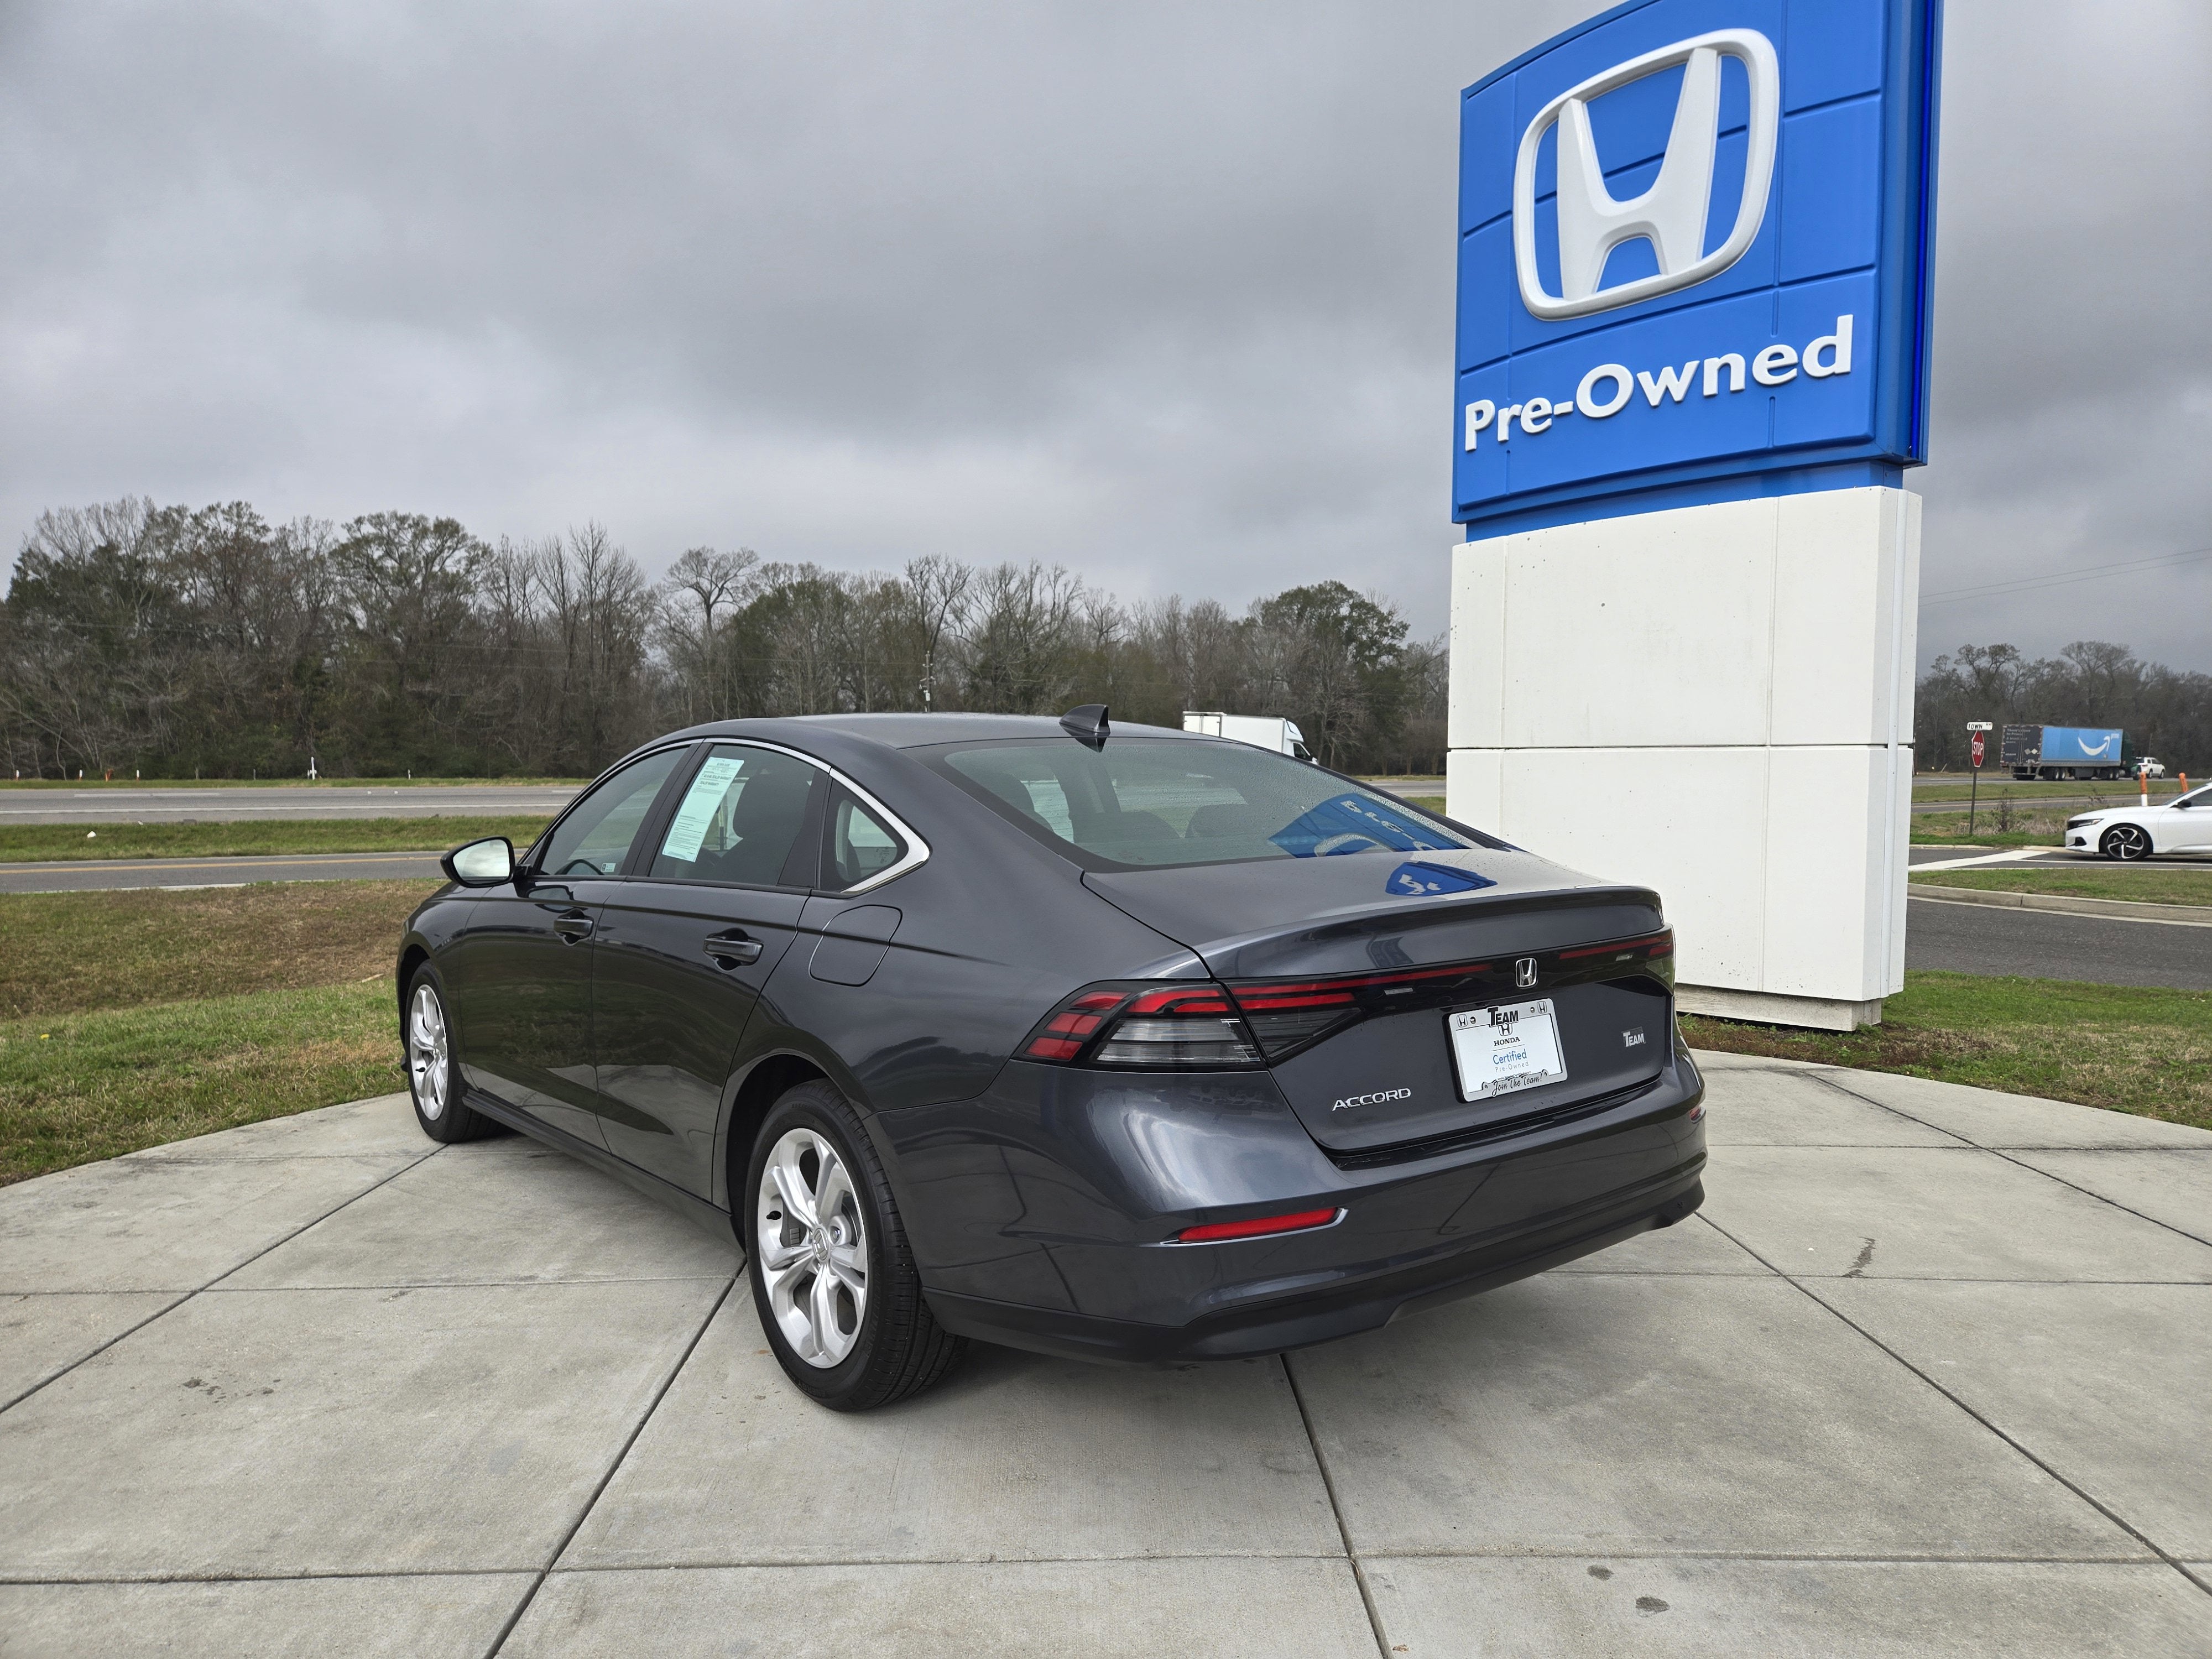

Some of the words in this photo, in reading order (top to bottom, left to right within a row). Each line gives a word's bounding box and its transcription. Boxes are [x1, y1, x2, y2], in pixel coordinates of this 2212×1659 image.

[1464, 314, 1854, 452] Pre-Owned
[1973, 741, 1984, 756] STOP
[1488, 1006, 1519, 1026] TEAM
[1494, 1036, 1520, 1046] HONDA
[1623, 1031, 1645, 1047] TEAM
[1493, 1048, 1527, 1065] Certified
[1495, 1060, 1529, 1073] Pre-Owned
[1492, 1081, 1507, 1096] Join
[1507, 1077, 1521, 1089] The
[1332, 1088, 1411, 1112] ACCORD
